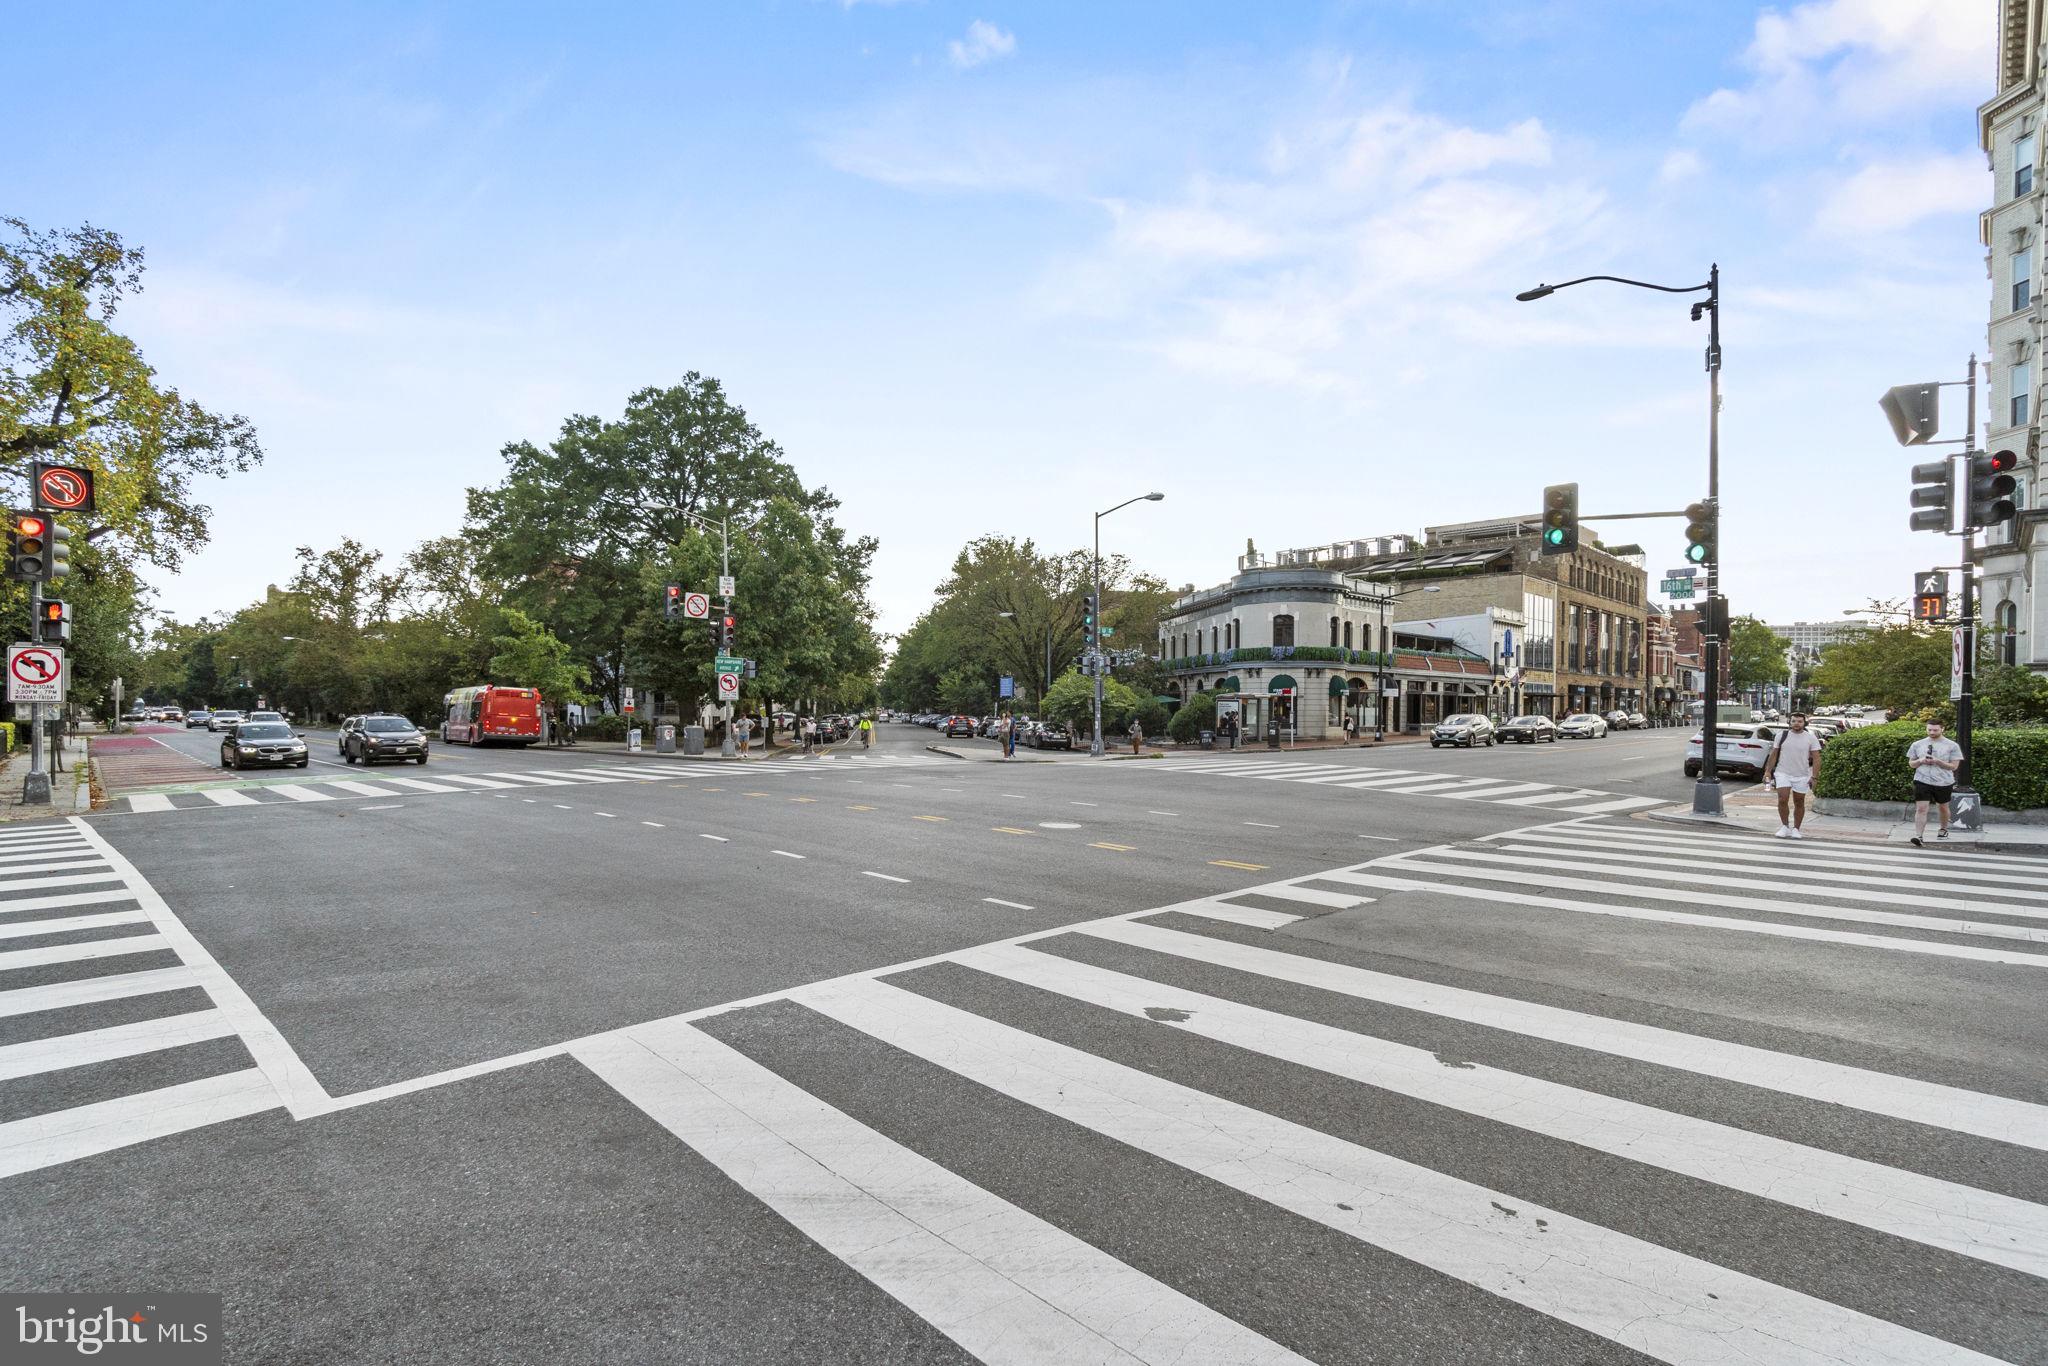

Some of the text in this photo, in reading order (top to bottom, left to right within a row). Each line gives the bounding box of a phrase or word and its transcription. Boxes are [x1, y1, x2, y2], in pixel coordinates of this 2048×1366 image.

[1663, 580, 1680, 591] 16th
[1670, 591, 1695, 599] 2000
[1921, 598, 1940, 617] 37
